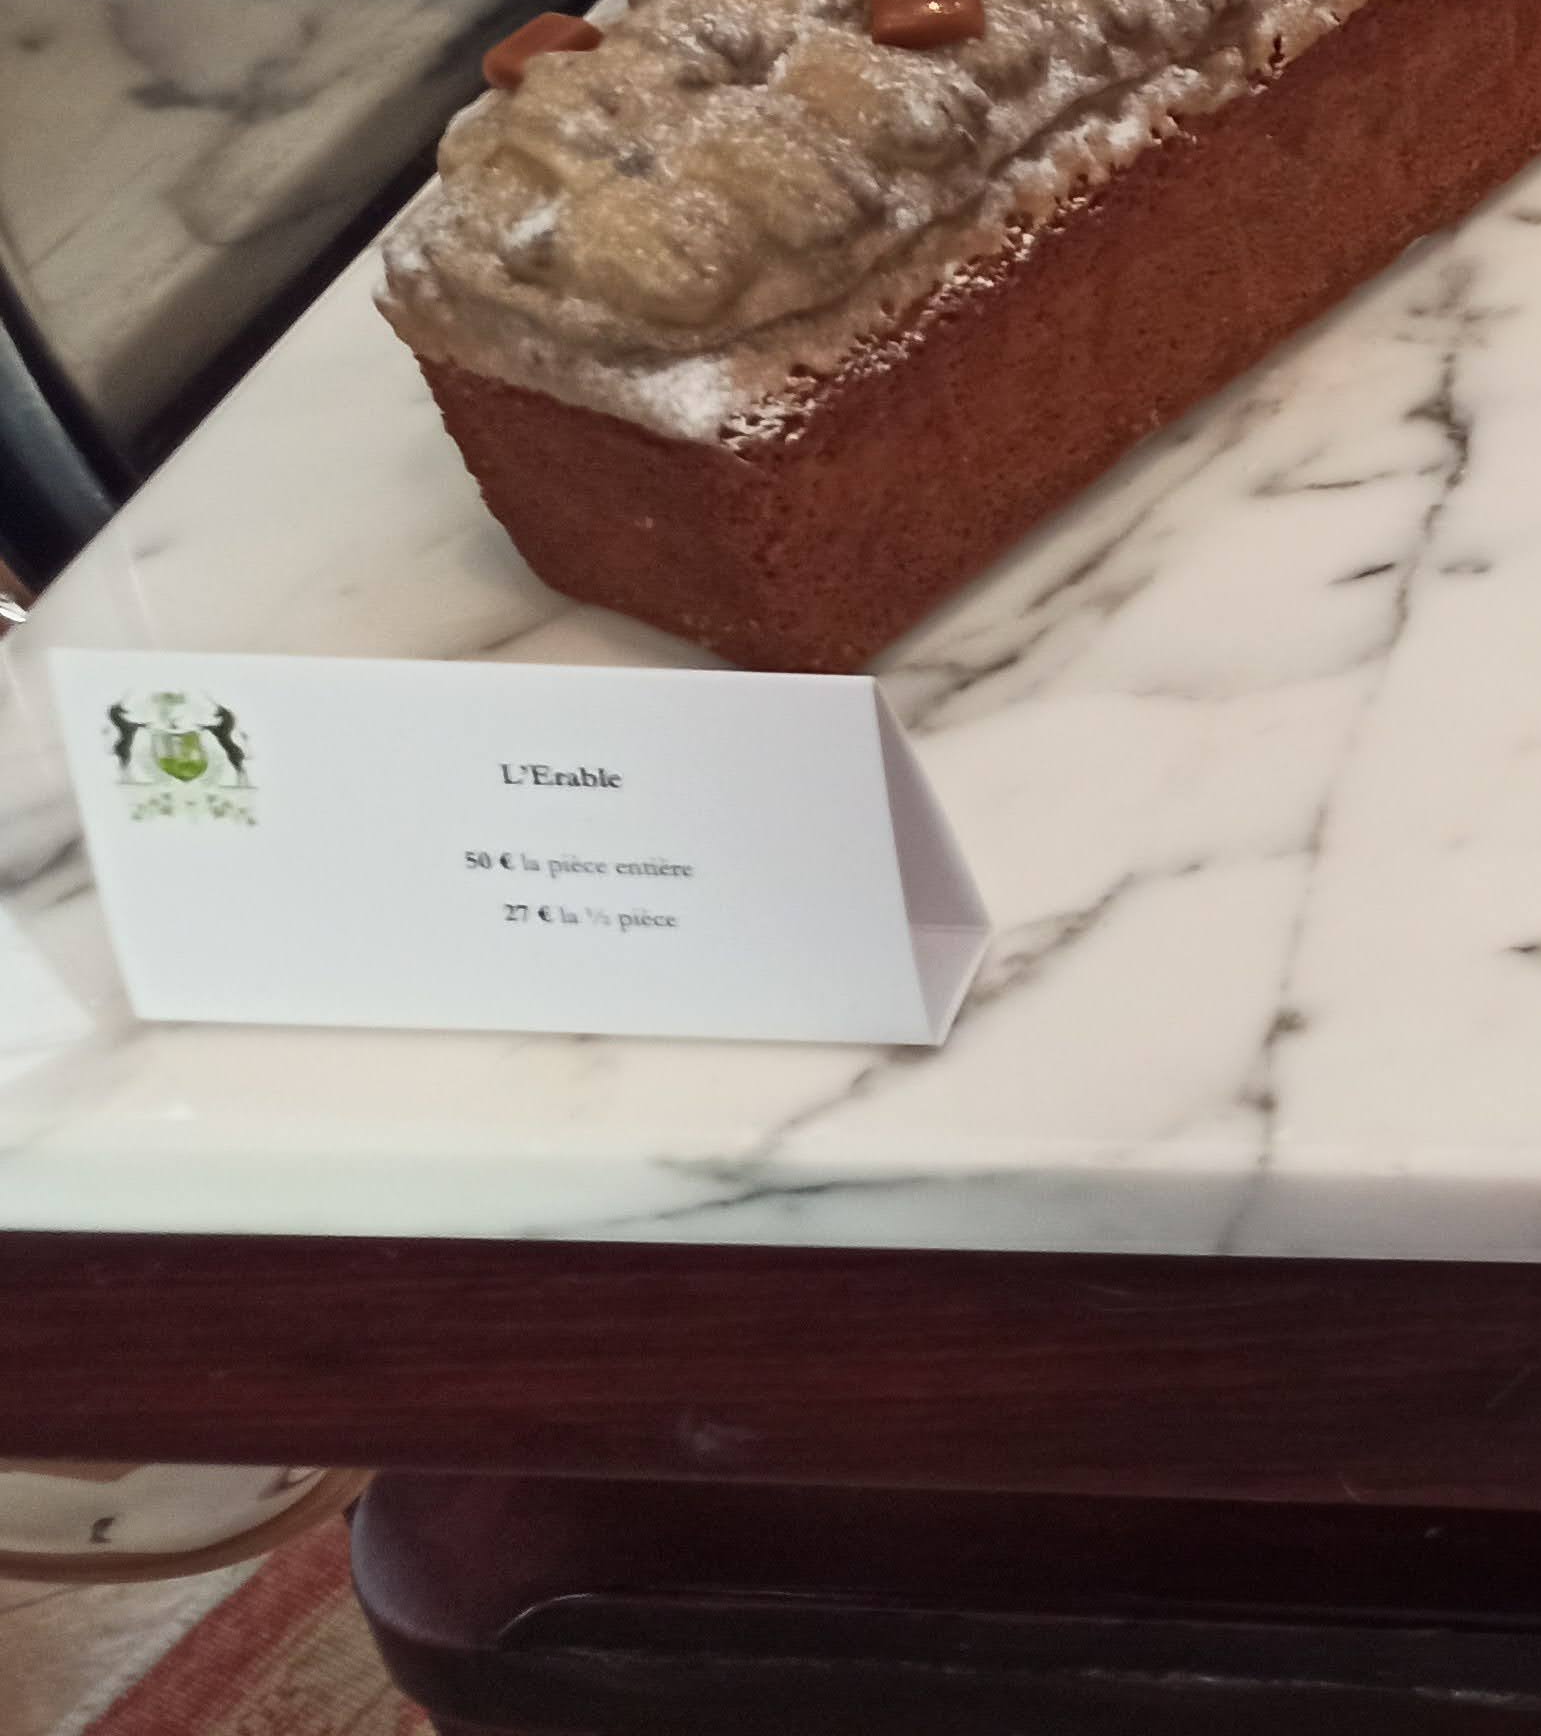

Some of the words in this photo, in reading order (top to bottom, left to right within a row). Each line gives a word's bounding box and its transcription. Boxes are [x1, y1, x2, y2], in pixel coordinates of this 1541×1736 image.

[499, 763, 624, 789] L'Erable
[464, 850, 492, 870] 50
[499, 852, 514, 871] €
[520, 852, 540, 872] la
[548, 854, 608, 878] pièce
[615, 856, 695, 877] entière
[503, 904, 529, 922] 27
[537, 905, 553, 923] €
[560, 906, 579, 924] la
[618, 908, 679, 932] pièce
